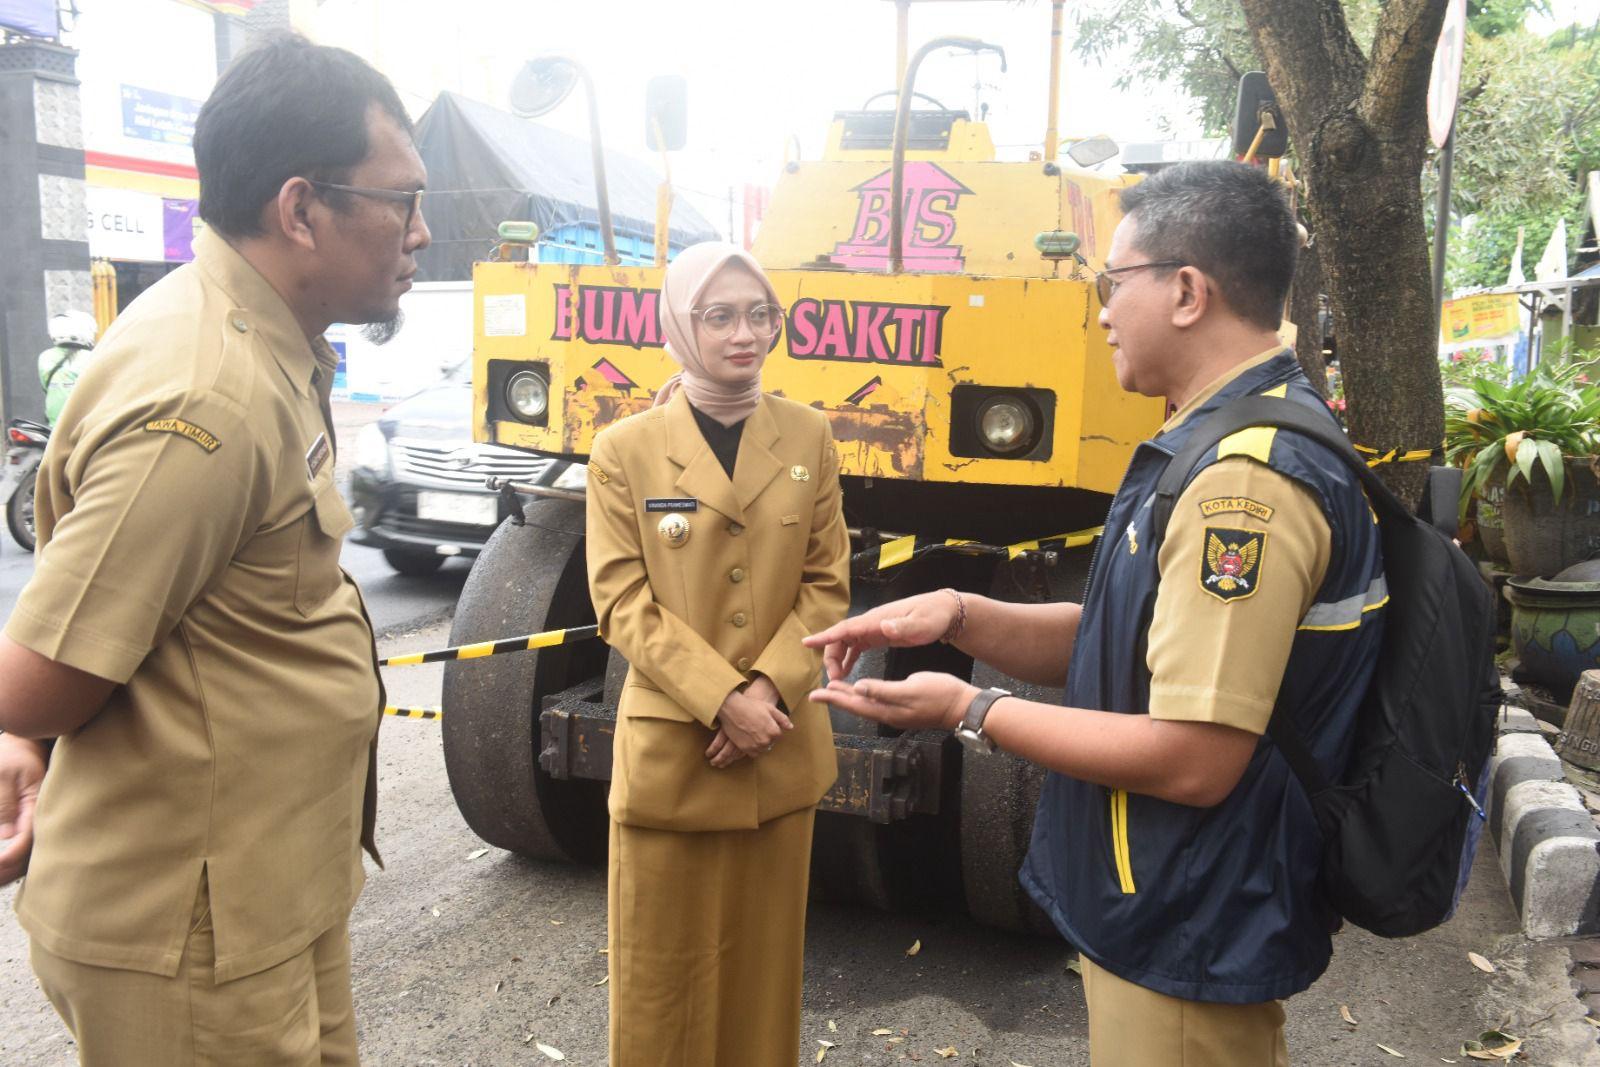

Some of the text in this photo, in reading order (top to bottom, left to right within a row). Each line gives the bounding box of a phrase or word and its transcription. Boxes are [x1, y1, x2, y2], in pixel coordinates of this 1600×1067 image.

[101, 213, 145, 233] CELL
[550, 283, 669, 350] BUM
[788, 298, 951, 368] SAKTI
[1204, 500, 1268, 517] KOTA KEDIRI
